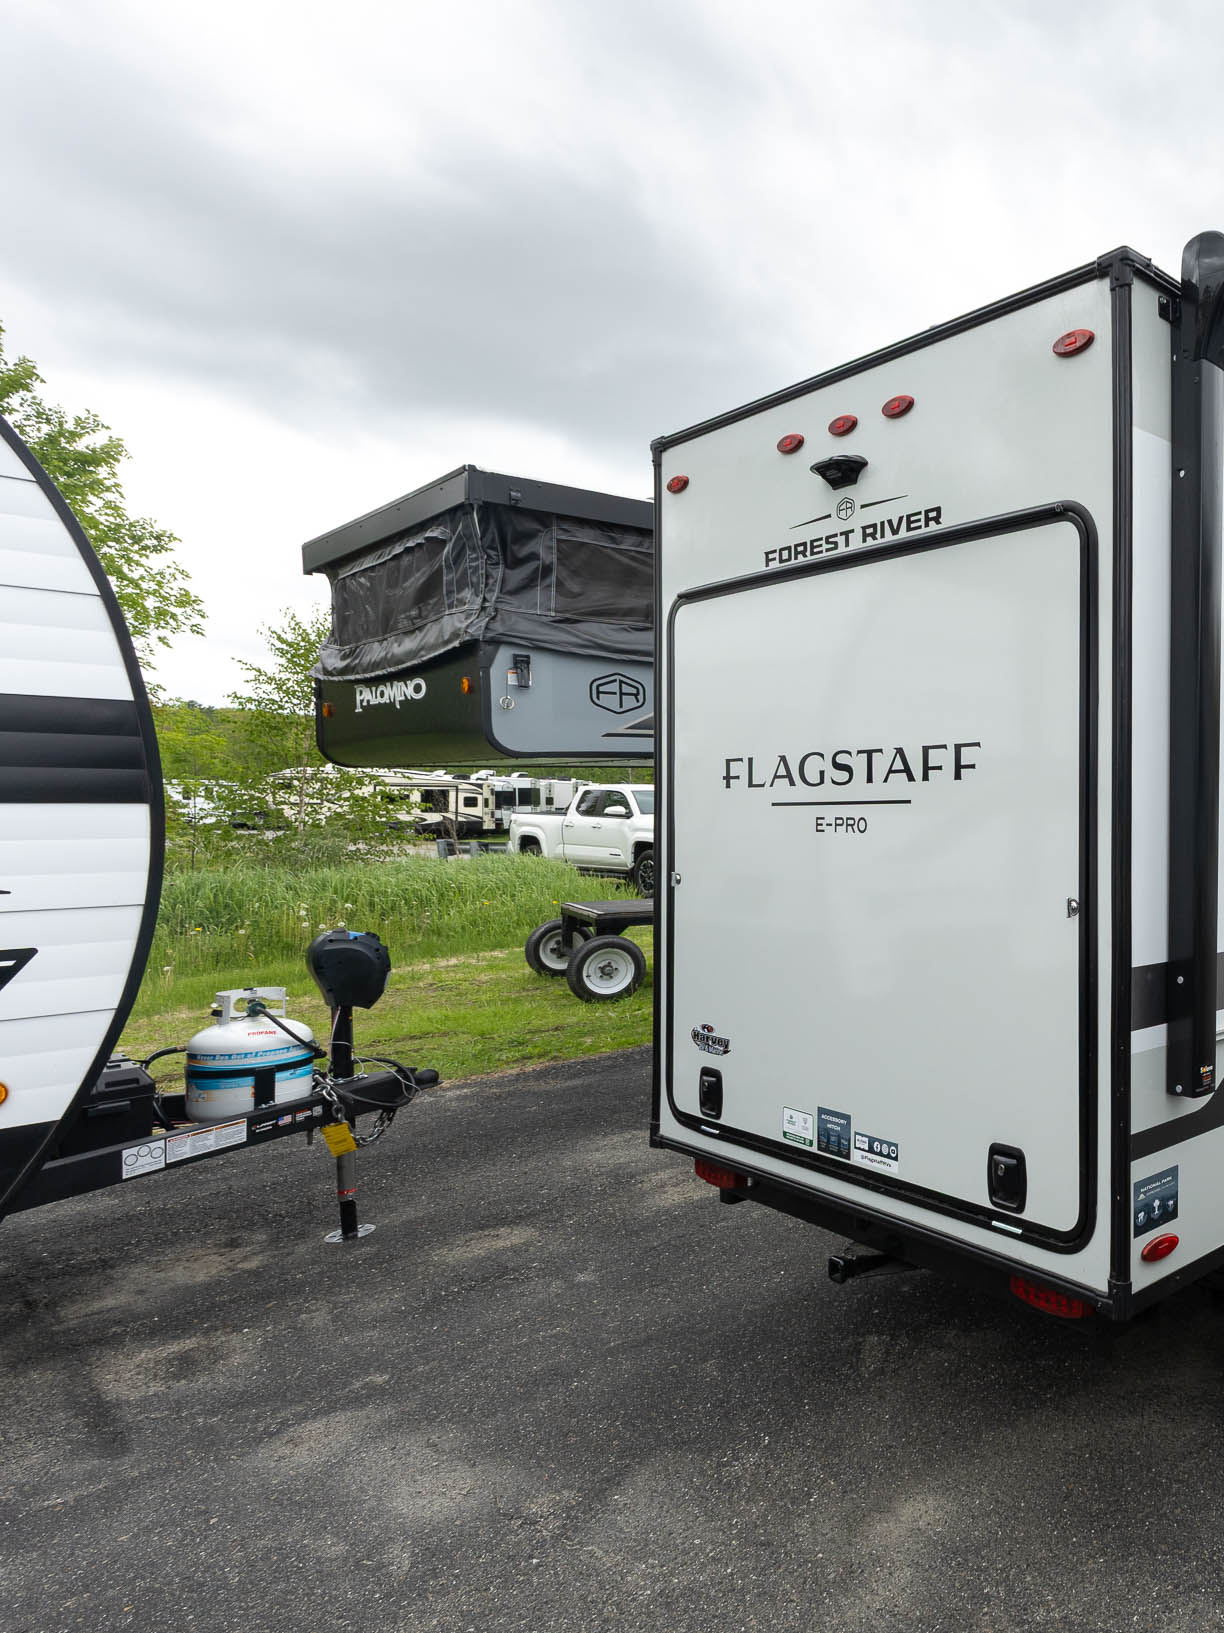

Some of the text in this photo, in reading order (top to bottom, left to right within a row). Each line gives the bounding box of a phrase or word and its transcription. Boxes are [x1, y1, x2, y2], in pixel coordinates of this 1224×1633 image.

[764, 505, 942, 568] FOREST RIVER
[354, 677, 427, 713] PALOMINO
[722, 741, 982, 789] FLAGSTAFF
[815, 816, 868, 834] E-PRO
